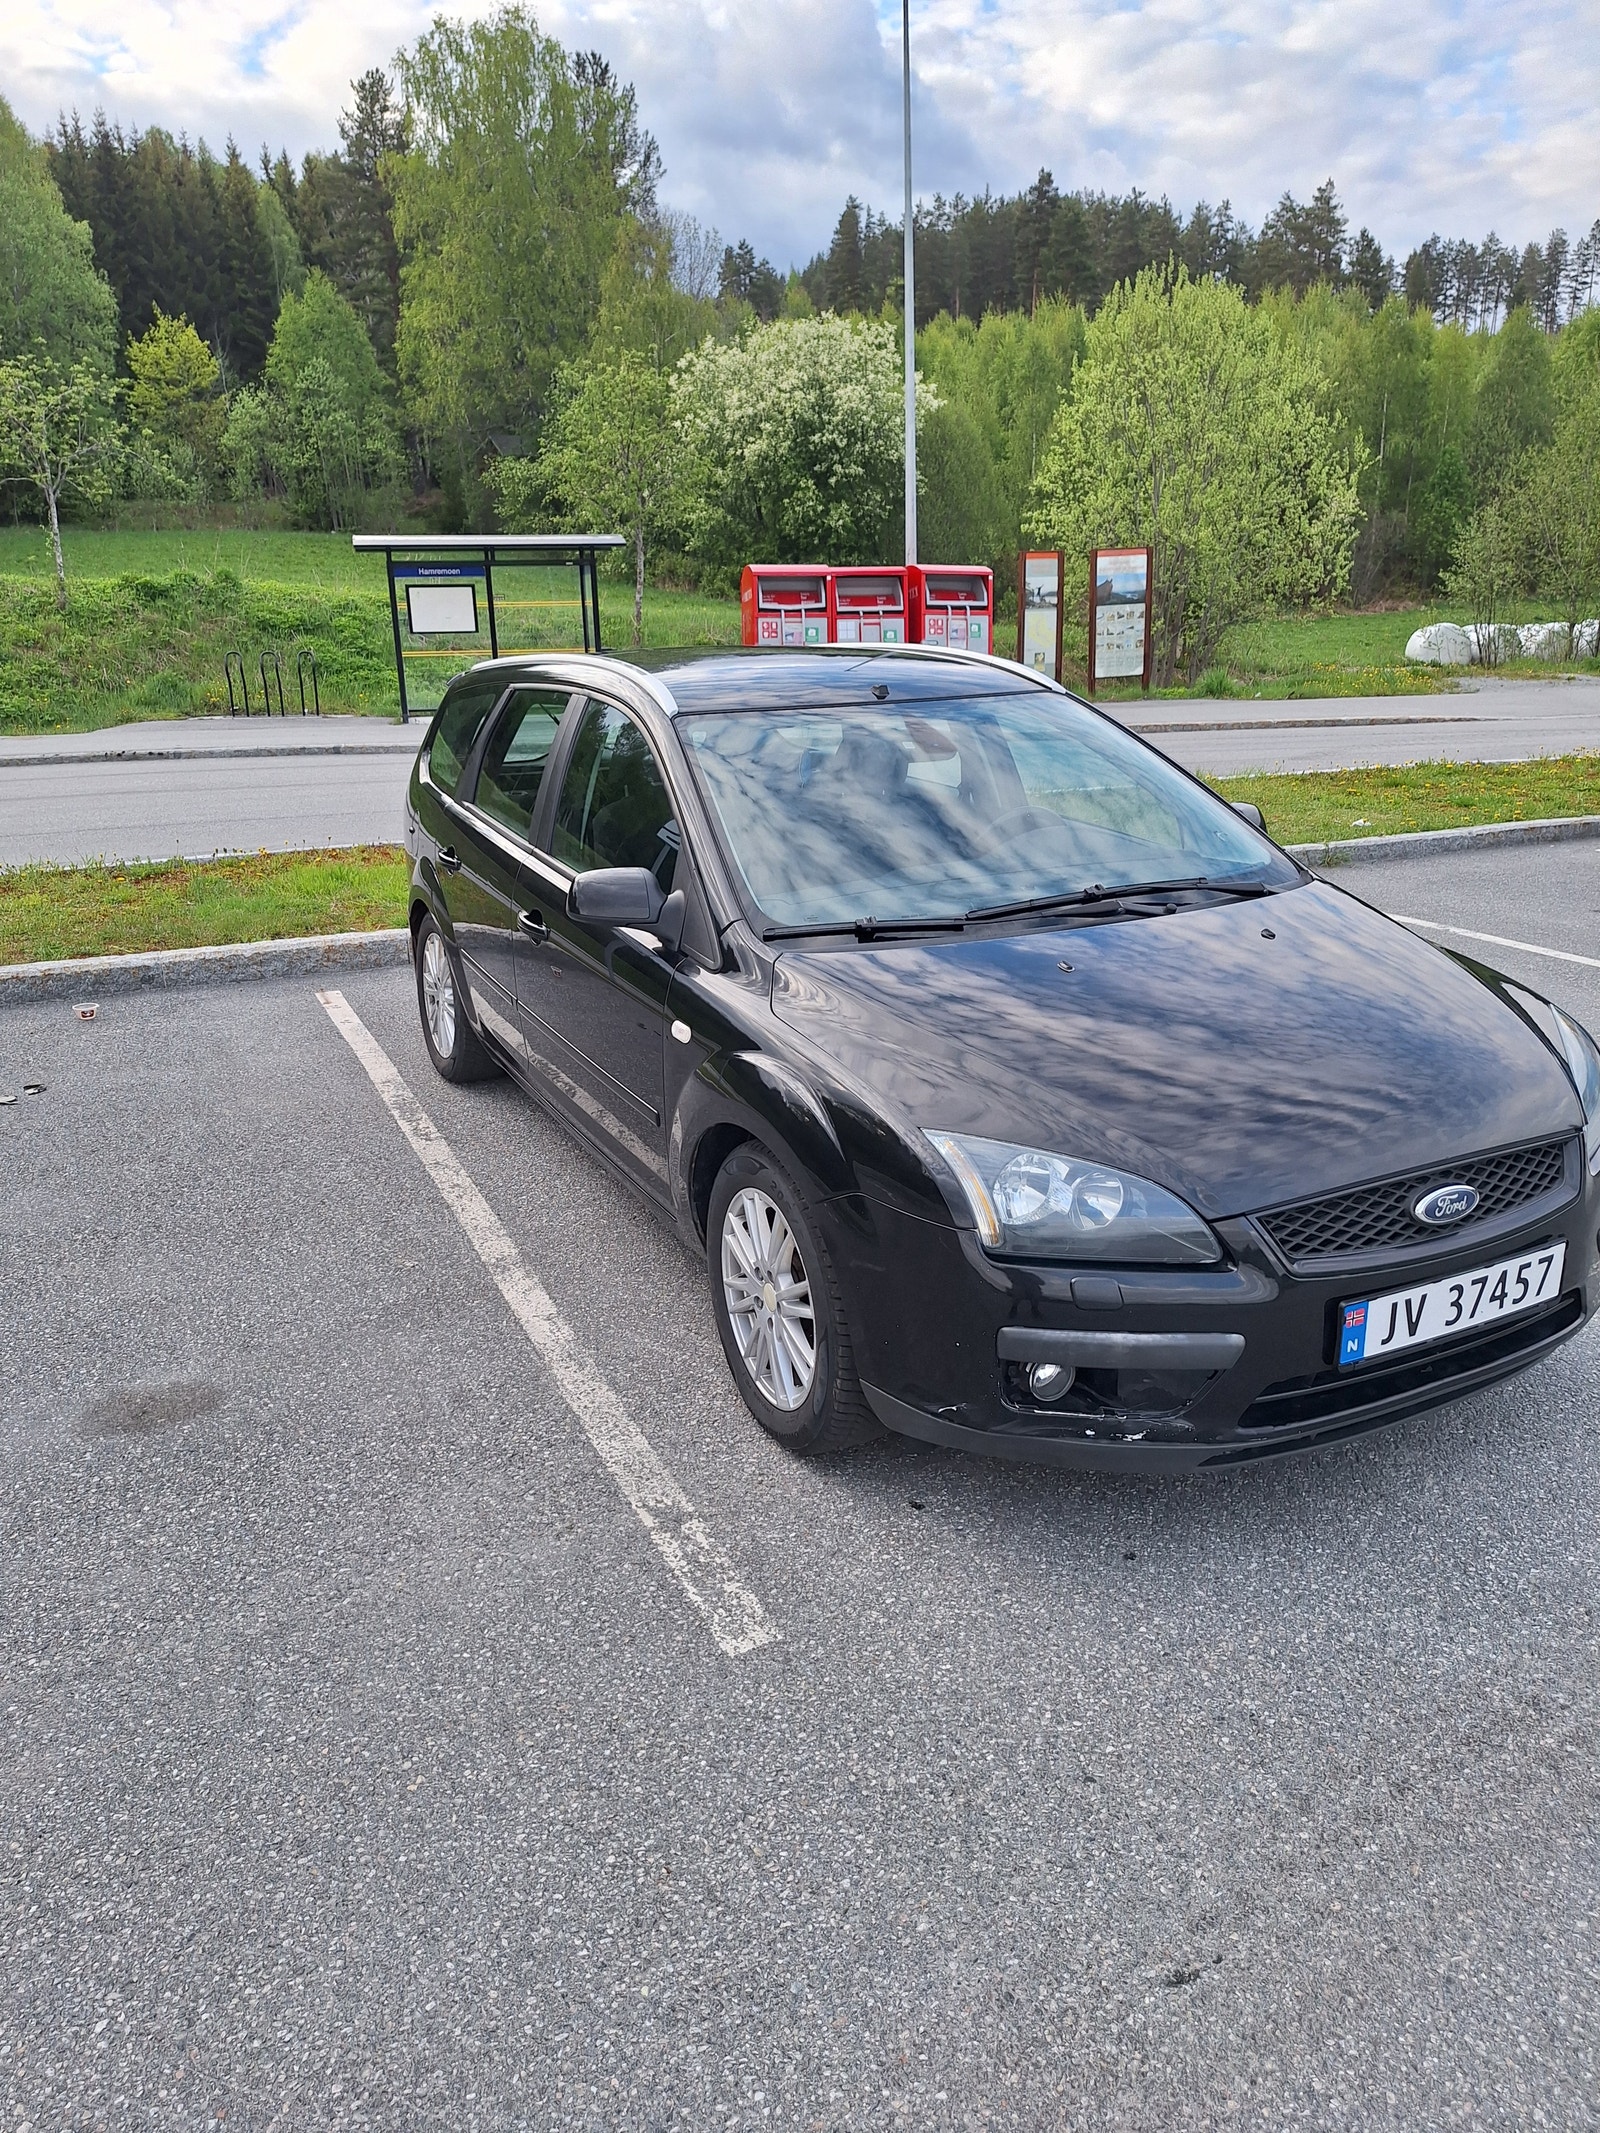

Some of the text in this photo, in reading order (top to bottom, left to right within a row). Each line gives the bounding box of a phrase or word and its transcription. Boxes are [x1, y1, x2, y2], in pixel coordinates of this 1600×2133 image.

[418, 567, 461, 575] Hamremoen
[1435, 1193, 1467, 1217] Ford
[1380, 1253, 1555, 1346] JV 37457
[1346, 1338, 1359, 1353] N
